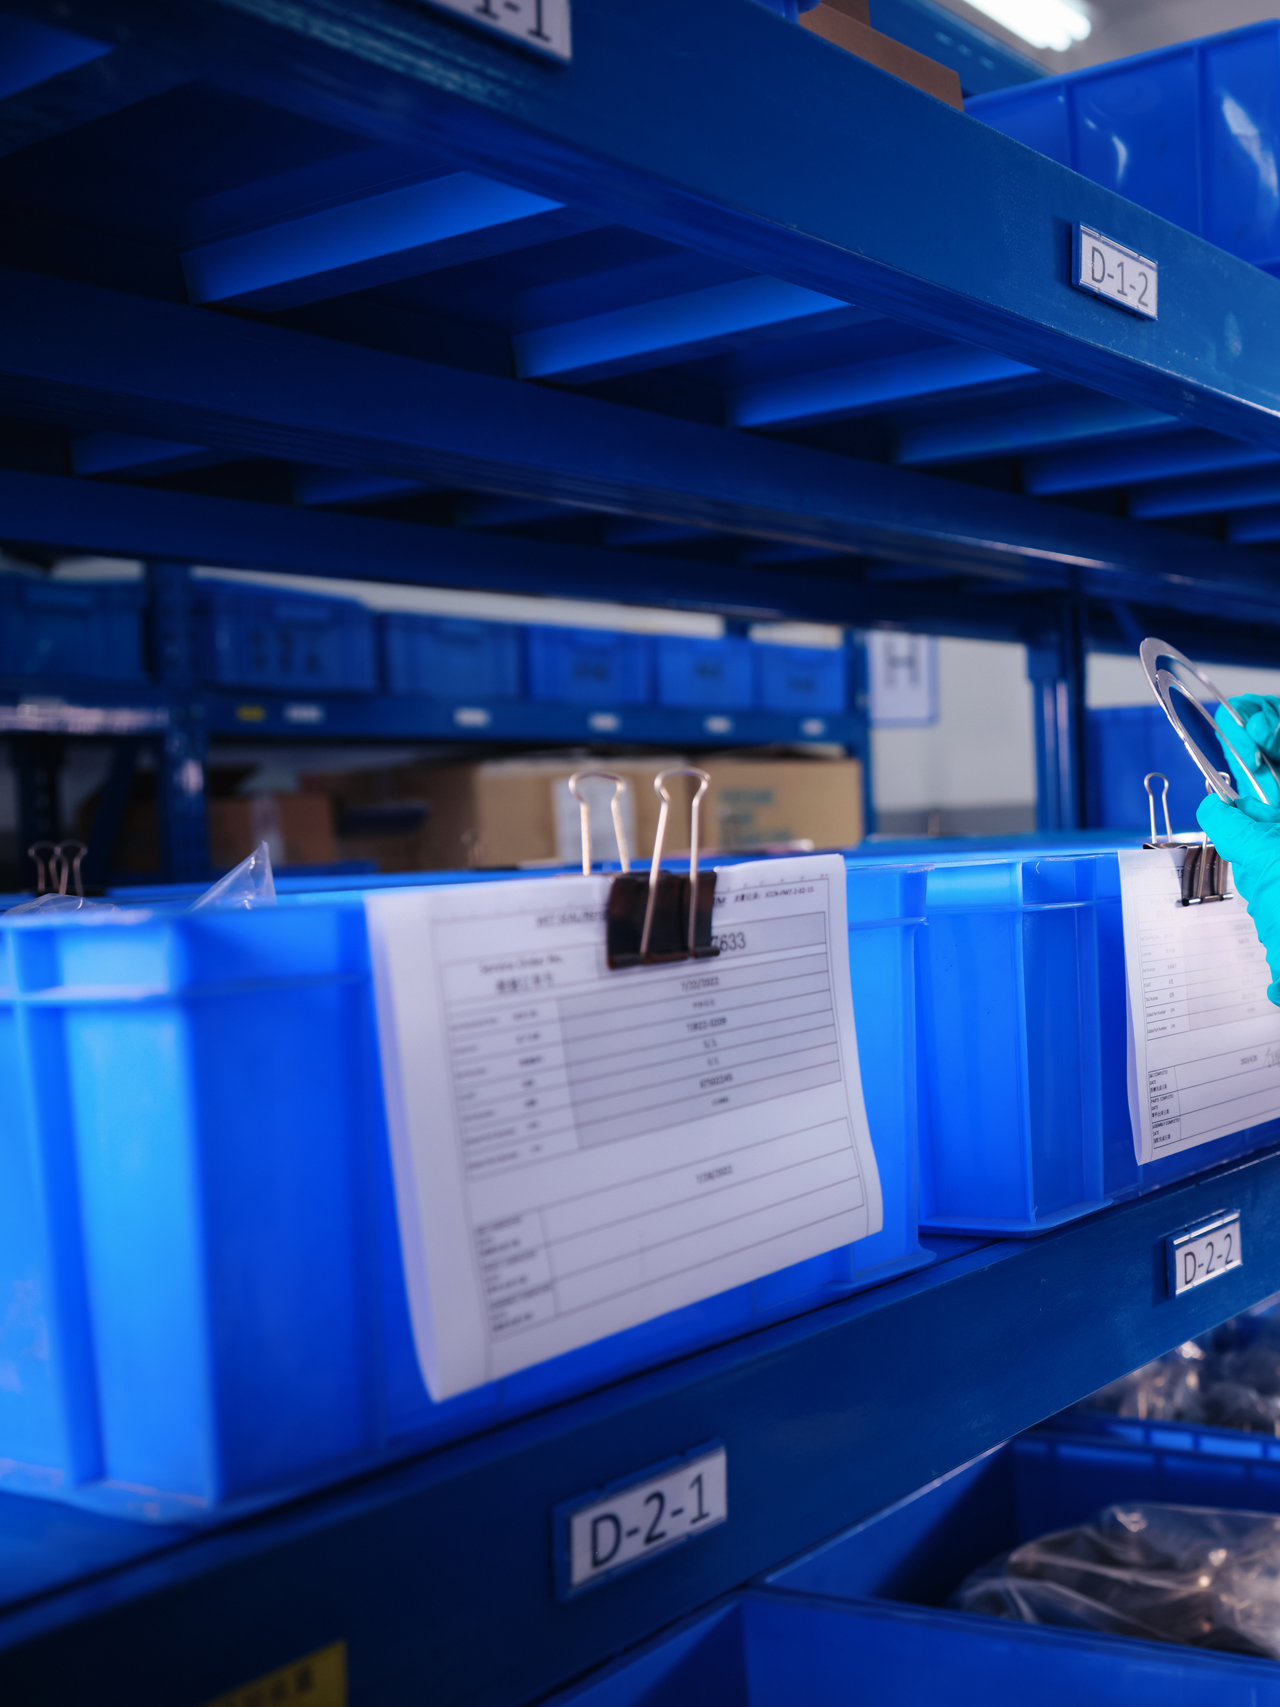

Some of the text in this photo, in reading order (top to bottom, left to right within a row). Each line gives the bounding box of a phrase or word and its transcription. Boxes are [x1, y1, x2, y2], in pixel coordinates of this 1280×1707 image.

[1091, 246, 1149, 307] D-1-2
[1184, 1233, 1233, 1286] D-2-2
[592, 1473, 710, 1568] D-2-1
